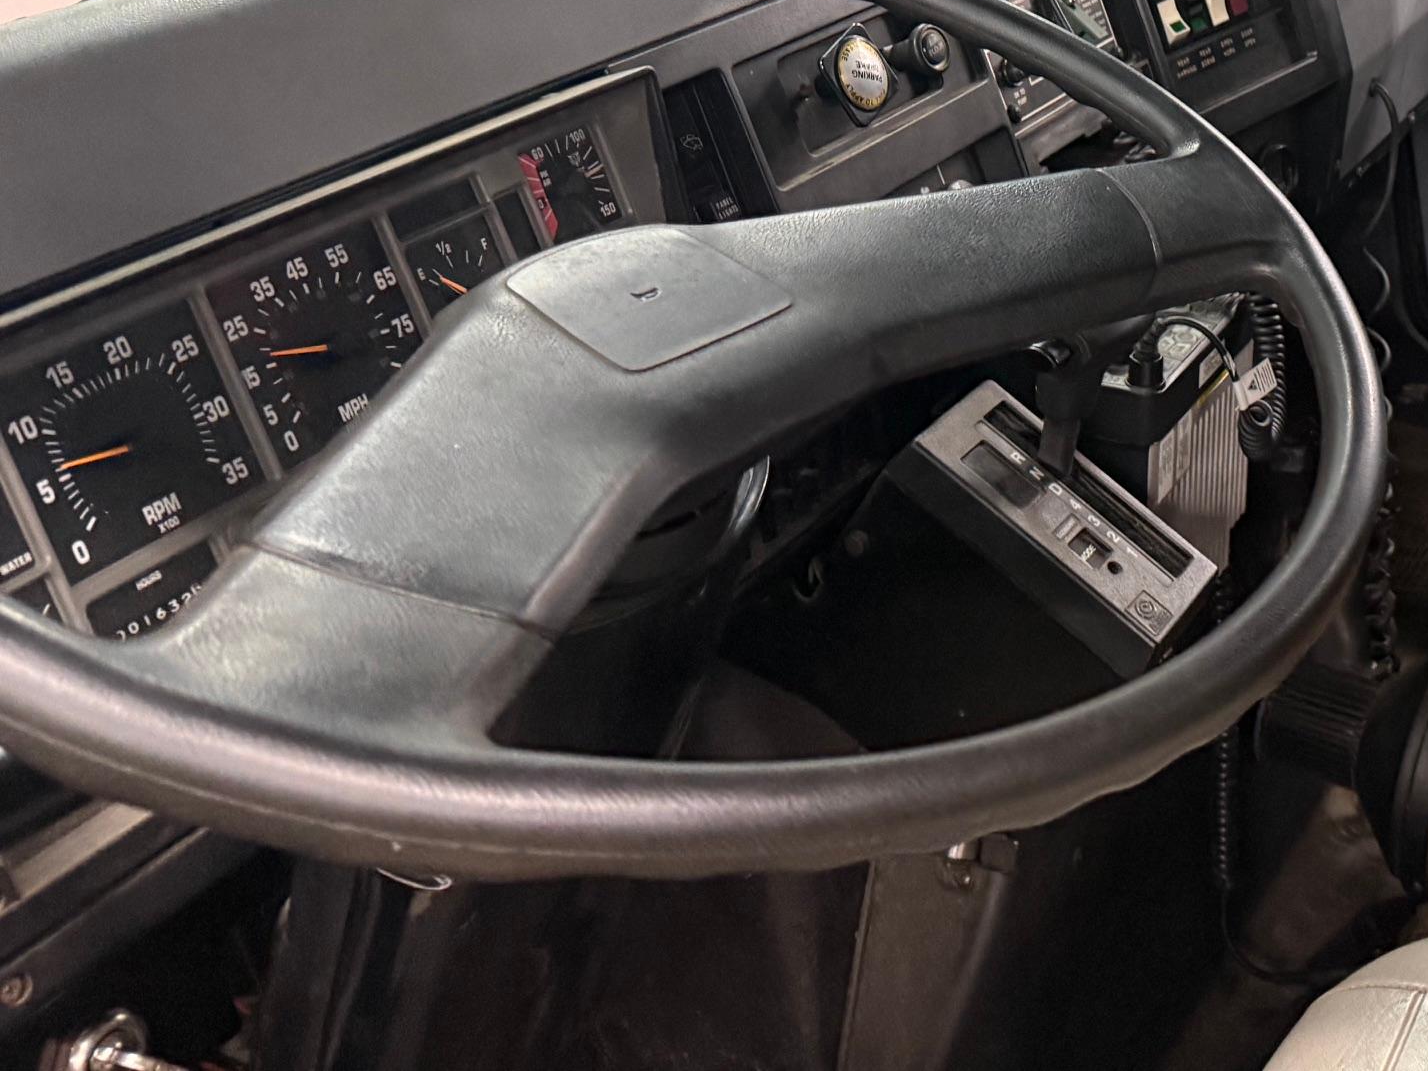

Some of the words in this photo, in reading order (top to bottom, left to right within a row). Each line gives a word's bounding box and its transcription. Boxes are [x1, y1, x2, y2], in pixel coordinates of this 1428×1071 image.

[852, 70, 883, 83] PARKING
[569, 128, 586, 144] 100
[601, 203, 616, 217] 150
[324, 244, 349, 268] 55
[481, 237, 488, 251] F
[286, 257, 308, 280] 45
[373, 266, 397, 290] 65
[417, 267, 425, 281] E
[250, 276, 275, 302] 35
[223, 315, 248, 342] 25
[391, 314, 414, 338] 75
[104, 335, 133, 365] 20
[171, 334, 200, 363] 25
[46, 361, 74, 389] 15
[241, 365, 261, 389] 15
[203, 395, 231, 423] 30
[263, 404, 279, 426] 5
[337, 393, 369, 422] MPH
[8, 415, 38, 444] 10
[284, 430, 299, 452] 0
[222, 456, 249, 485] 35
[36, 479, 56, 504] 5
[142, 492, 182, 526] RPM
[1010, 451, 1026, 465] R
[1029, 466, 1045, 481] N
[1049, 483, 1063, 496] D
[1069, 499, 1082, 510] 4
[1088, 515, 1101, 528] 3
[1107, 531, 1120, 543] 2
[1126, 546, 1139, 558] 1
[71, 539, 91, 565] 0
[1081, 544, 1097, 561] MODE
